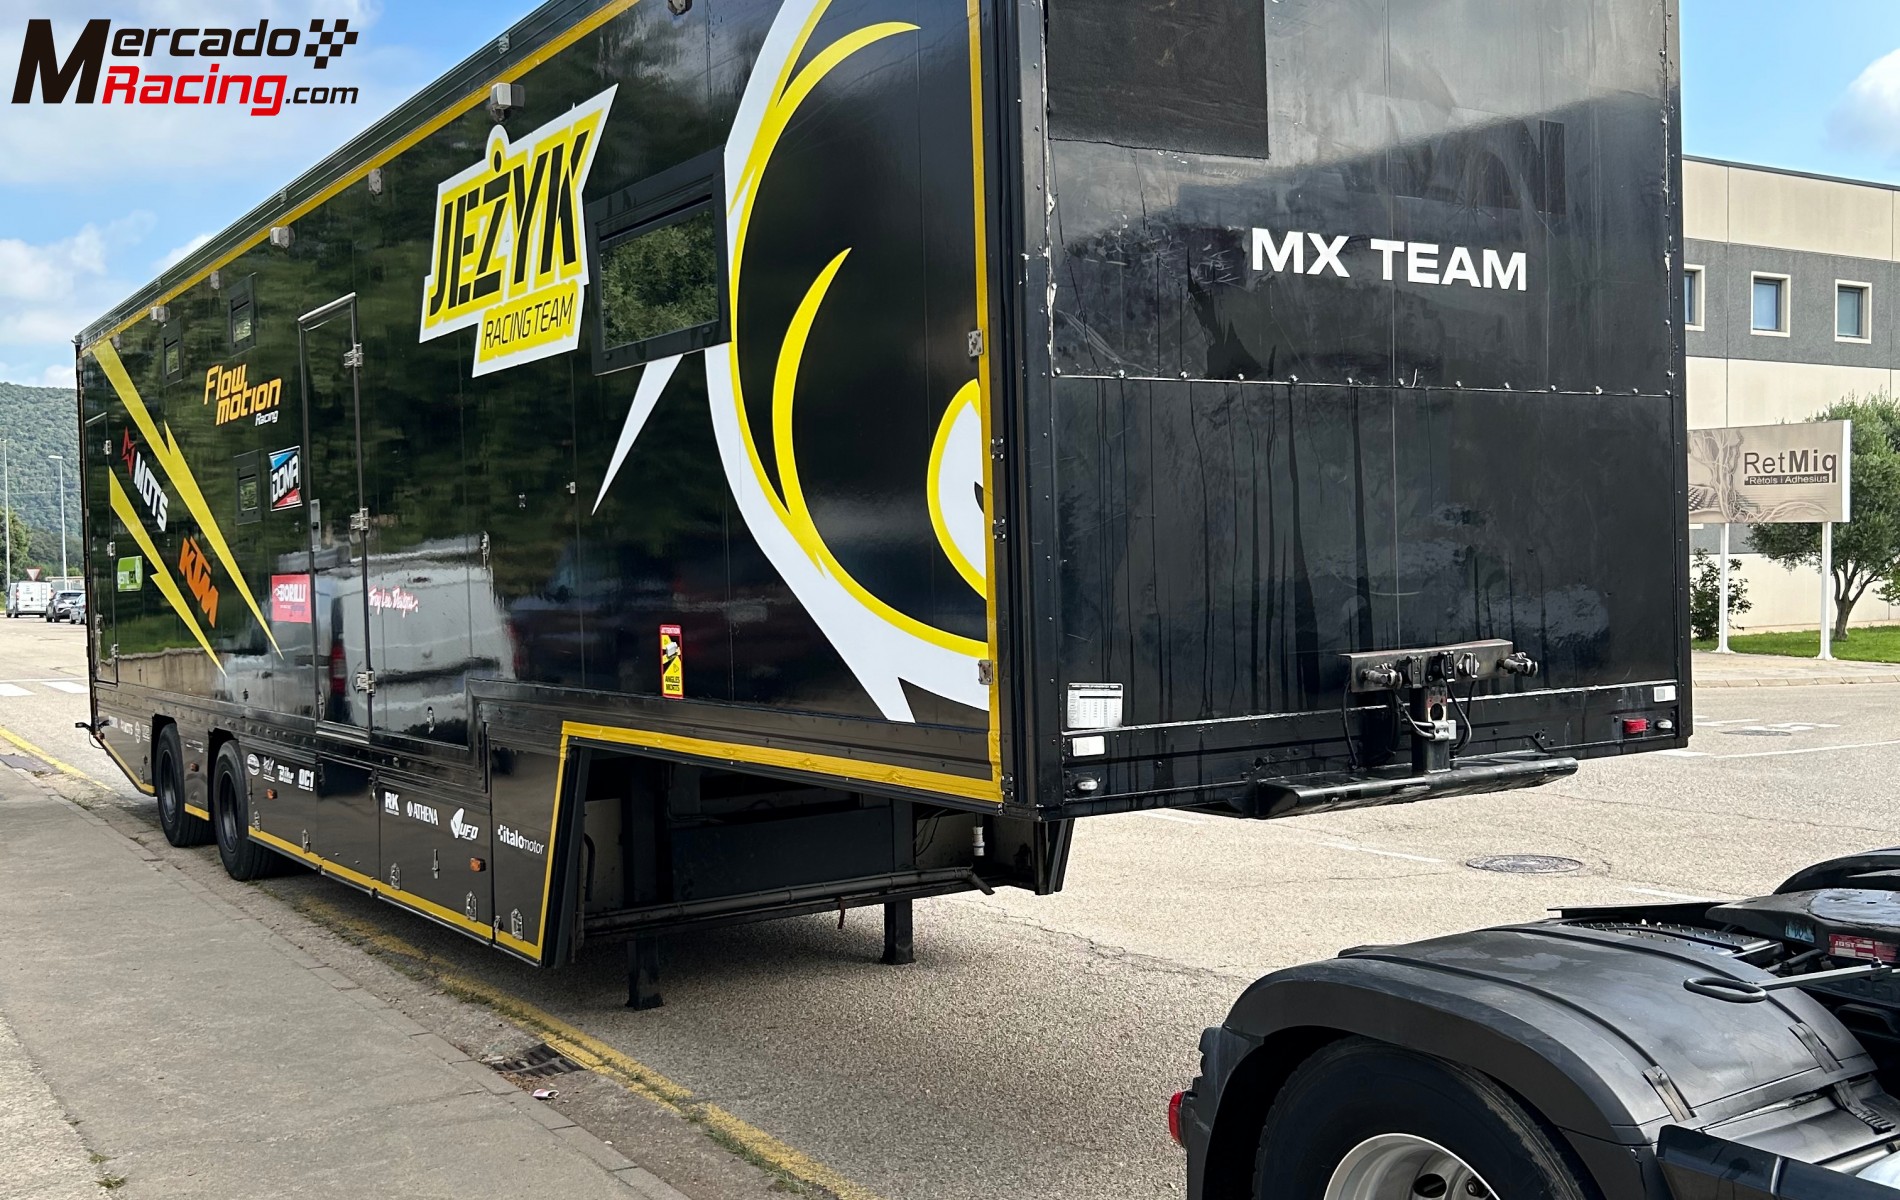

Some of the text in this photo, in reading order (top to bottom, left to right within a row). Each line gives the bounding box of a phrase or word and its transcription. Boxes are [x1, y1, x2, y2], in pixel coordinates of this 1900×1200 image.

[430, 130, 589, 316] JEŻYK
[1252, 228, 1527, 291] MX TEAM
[484, 293, 574, 350] RACING TEAM
[204, 364, 247, 405] Flow
[216, 378, 282, 426] motion
[255, 410, 279, 426] Racing
[1744, 449, 1837, 483] RetMiq
[1785, 474, 1828, 484] Adhesius
[134, 451, 169, 532] MOTS
[178, 536, 219, 628] KTM
[385, 791, 400, 811] RK
[412, 802, 439, 826] ATHENA
[460, 822, 479, 839] UFO
[1834, 940, 1856, 948] JOST
